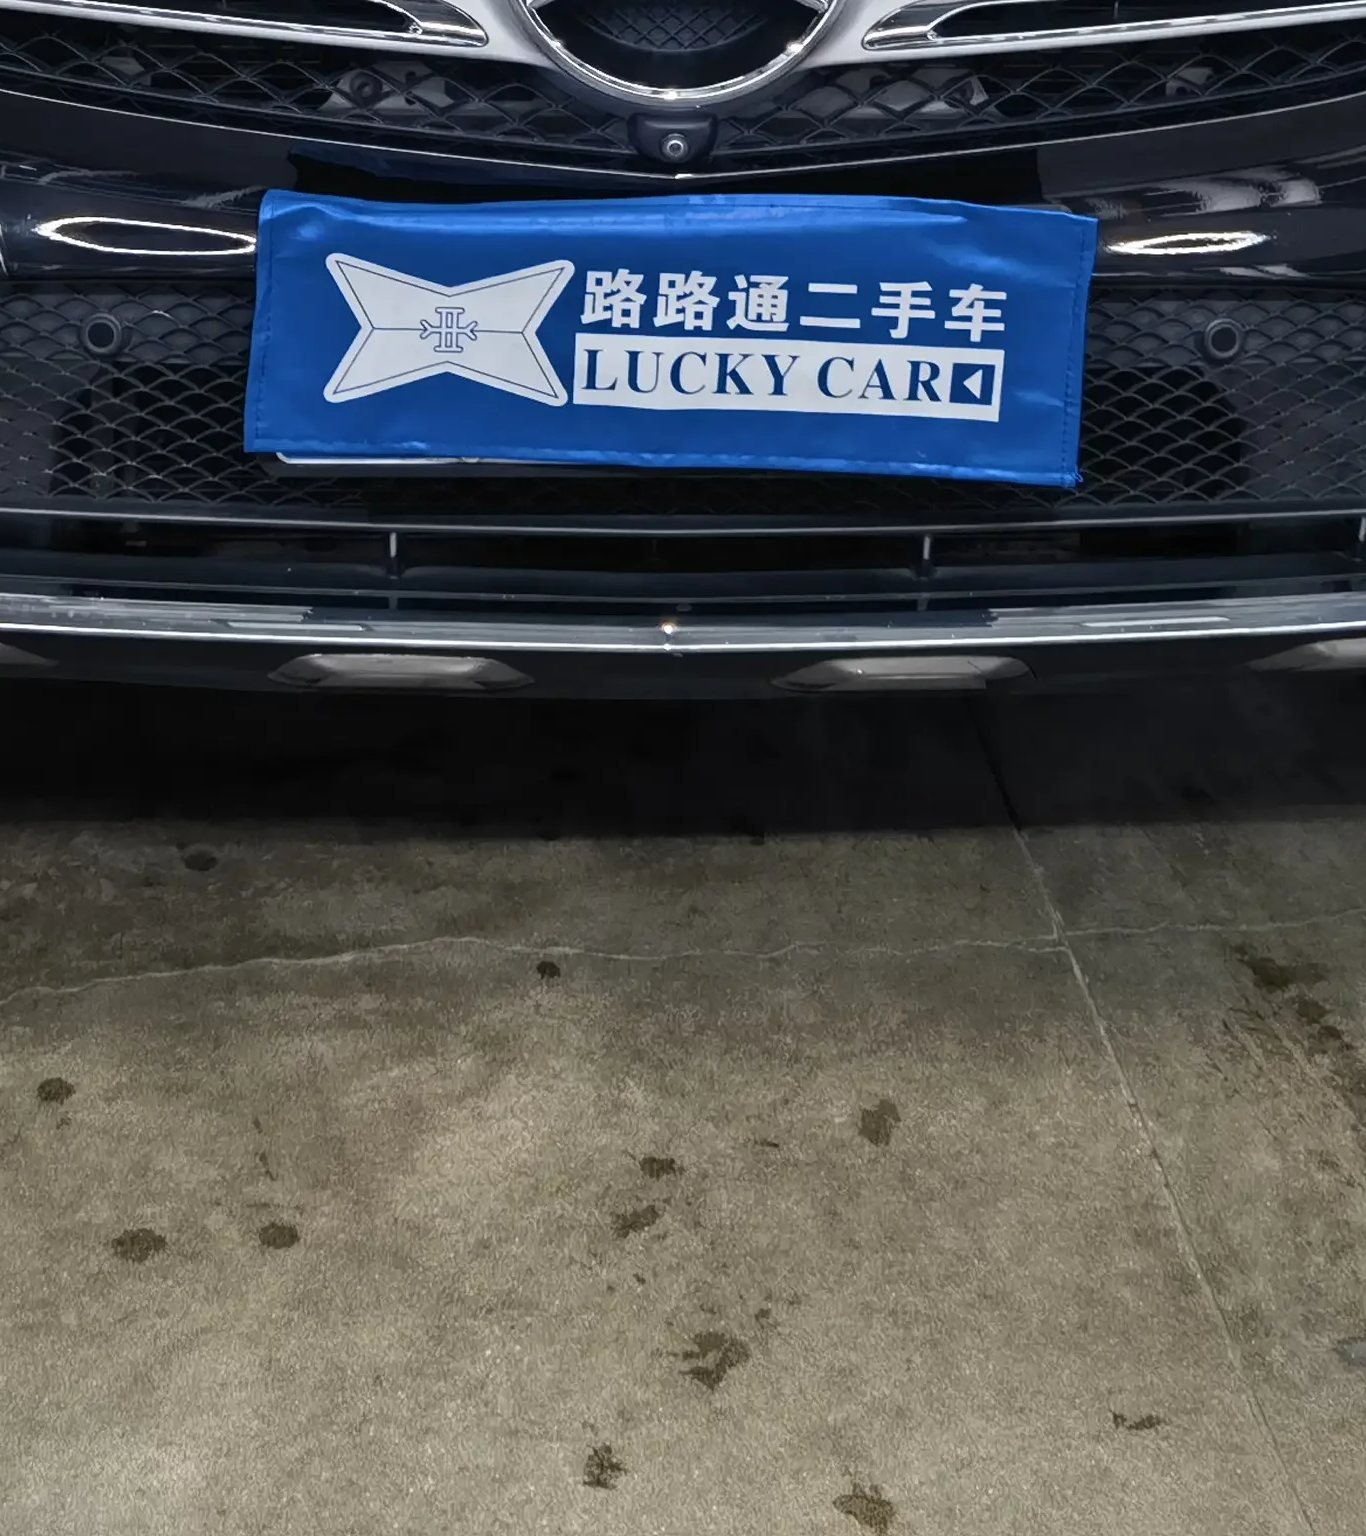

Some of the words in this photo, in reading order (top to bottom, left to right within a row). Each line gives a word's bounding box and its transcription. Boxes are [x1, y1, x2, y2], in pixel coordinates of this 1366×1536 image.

[580, 268, 1008, 343] 路路通二手车
[581, 348, 801, 397] LUCKY
[816, 356, 943, 403] CAR
